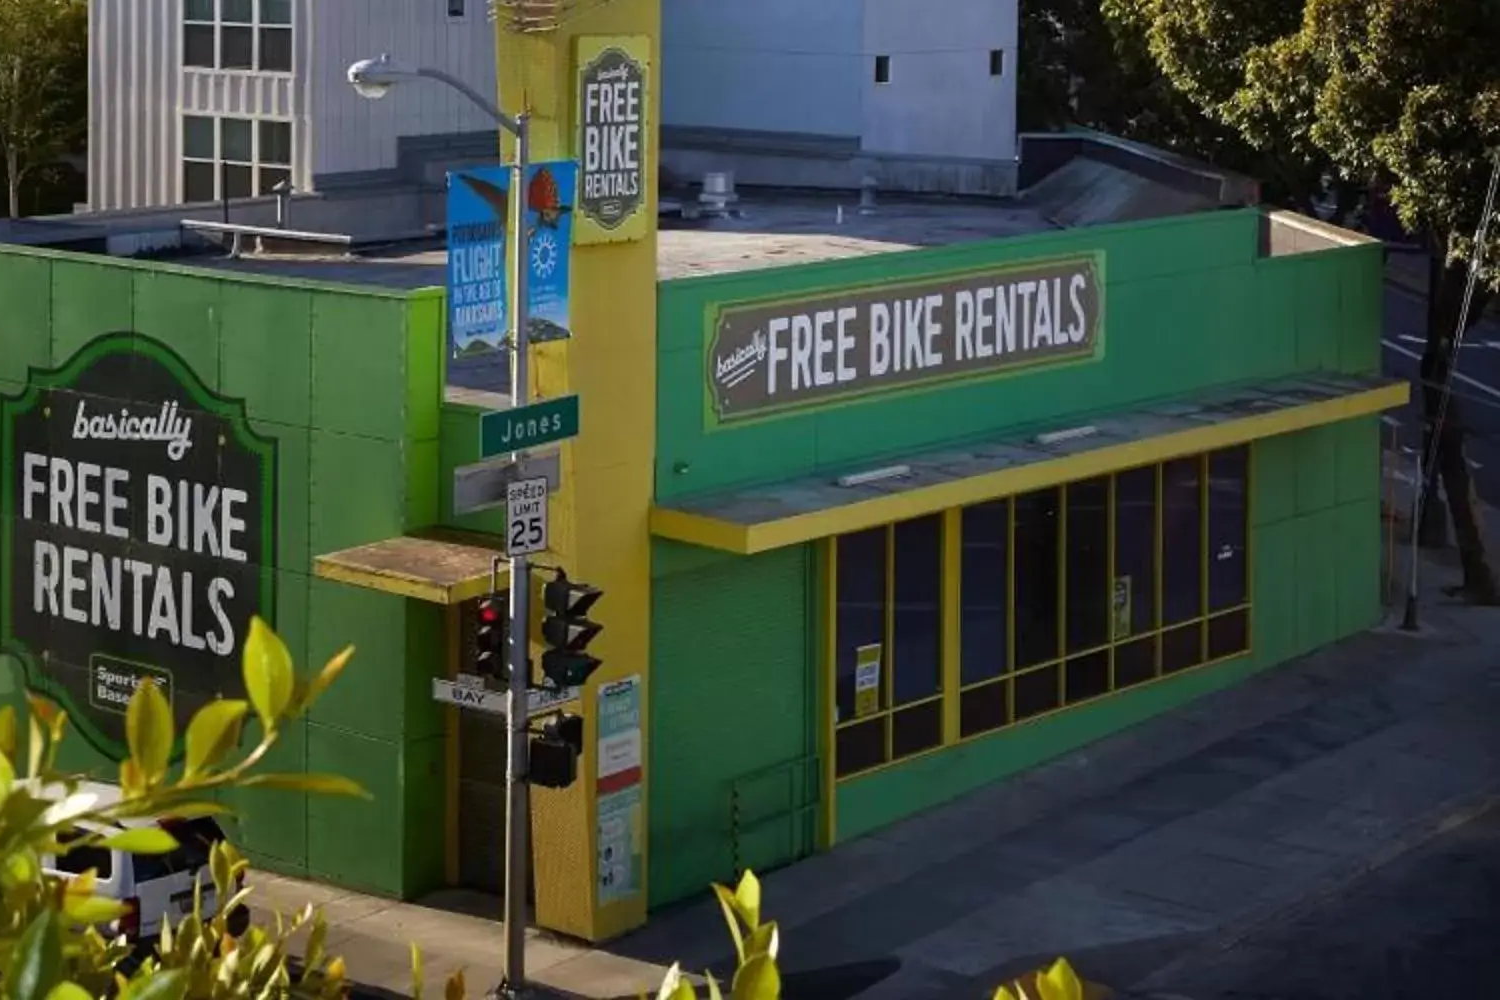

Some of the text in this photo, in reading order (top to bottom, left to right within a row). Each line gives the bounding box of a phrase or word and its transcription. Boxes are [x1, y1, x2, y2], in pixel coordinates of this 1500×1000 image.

[585, 82, 639, 123] FREE
[585, 124, 639, 172] BIKE
[585, 172, 639, 199] RENTALS
[715, 273, 1087, 394] basically FREE BIKE RENTALS
[73, 399, 192, 461] basically
[501, 413, 562, 443] Jones
[23, 452, 248, 562] FREE BIKE
[513, 502, 541, 516] LIMIT
[511, 517, 543, 547] 25
[33, 540, 236, 656] RENTALS
